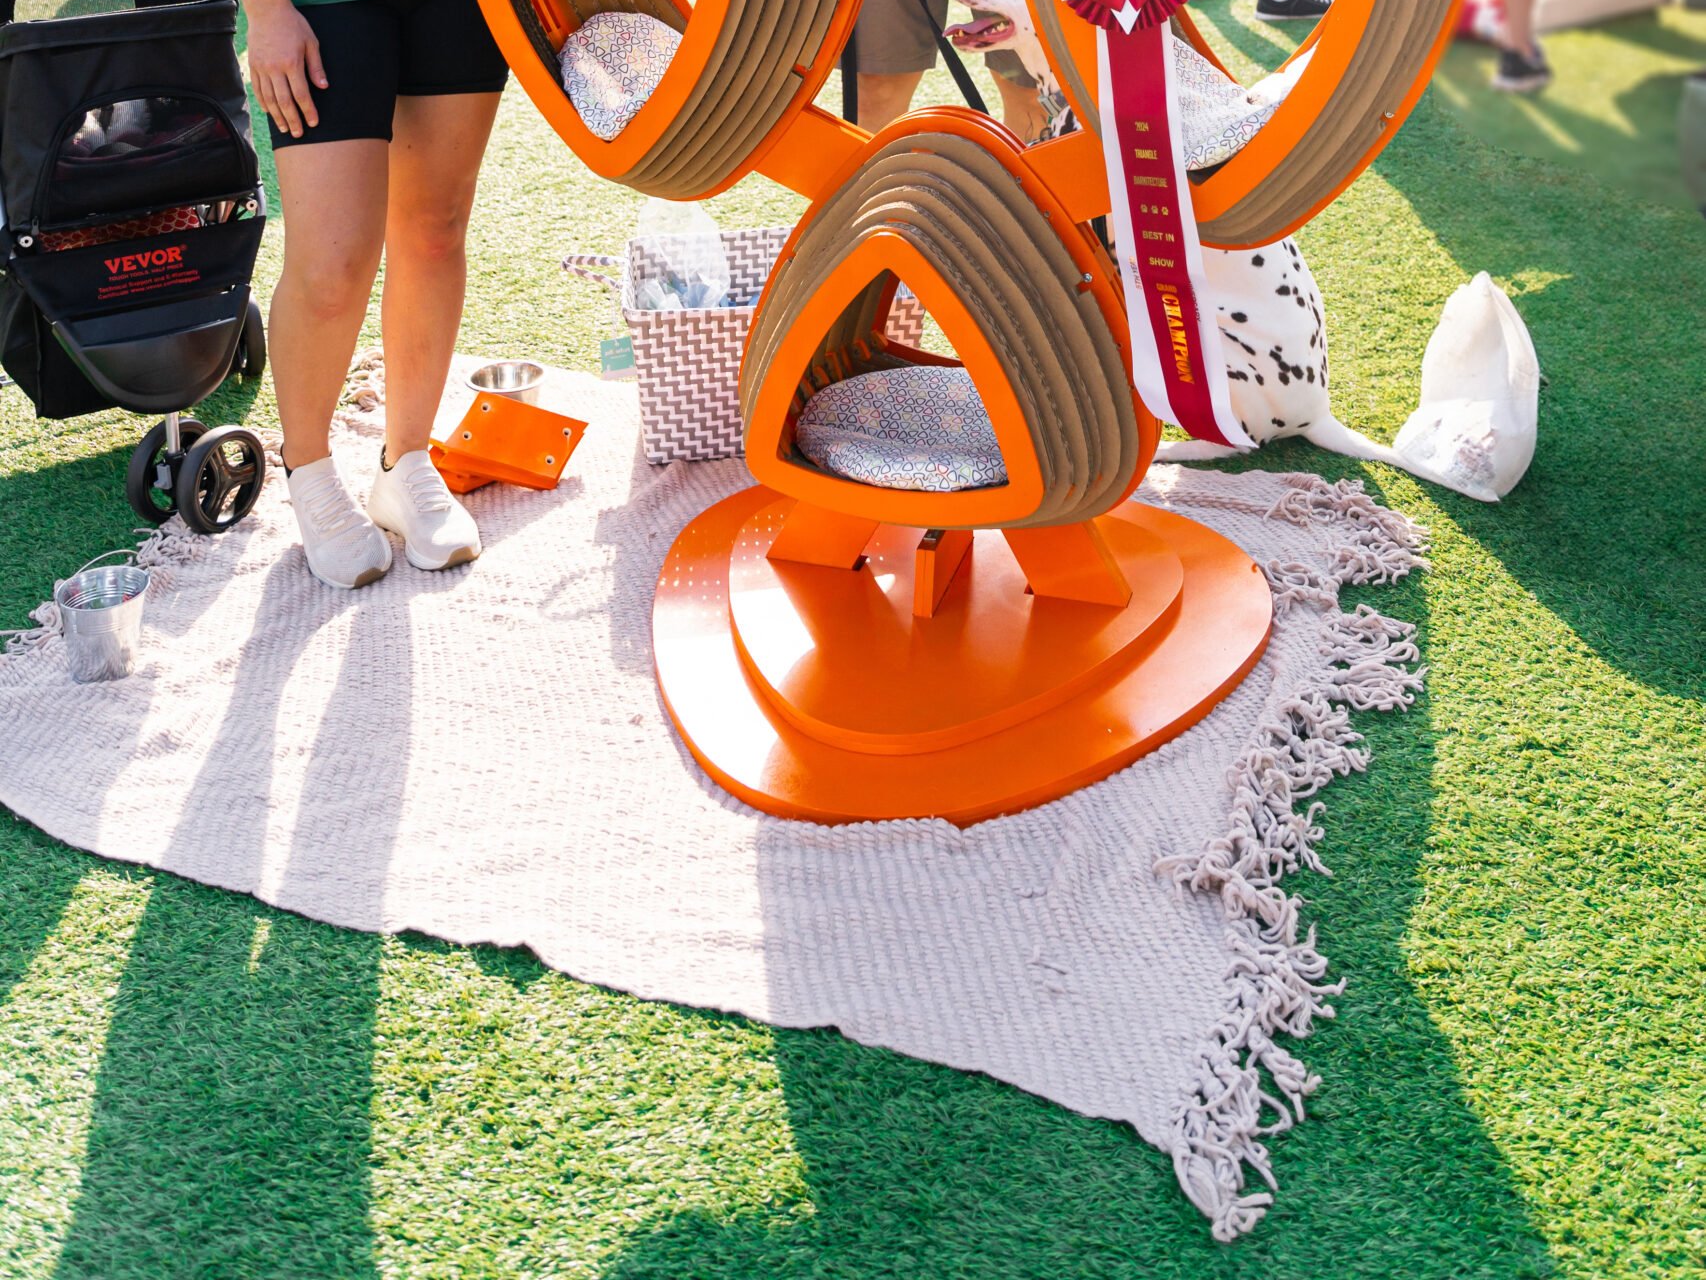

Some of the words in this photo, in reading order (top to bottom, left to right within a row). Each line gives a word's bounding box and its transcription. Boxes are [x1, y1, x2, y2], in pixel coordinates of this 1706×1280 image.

[1134, 148, 1158, 160] TRIANGLE
[1142, 230, 1164, 241] BEST
[1165, 232, 1175, 242] IN
[1149, 257, 1175, 268] SHOW
[1161, 293, 1195, 385] CHAMPION
